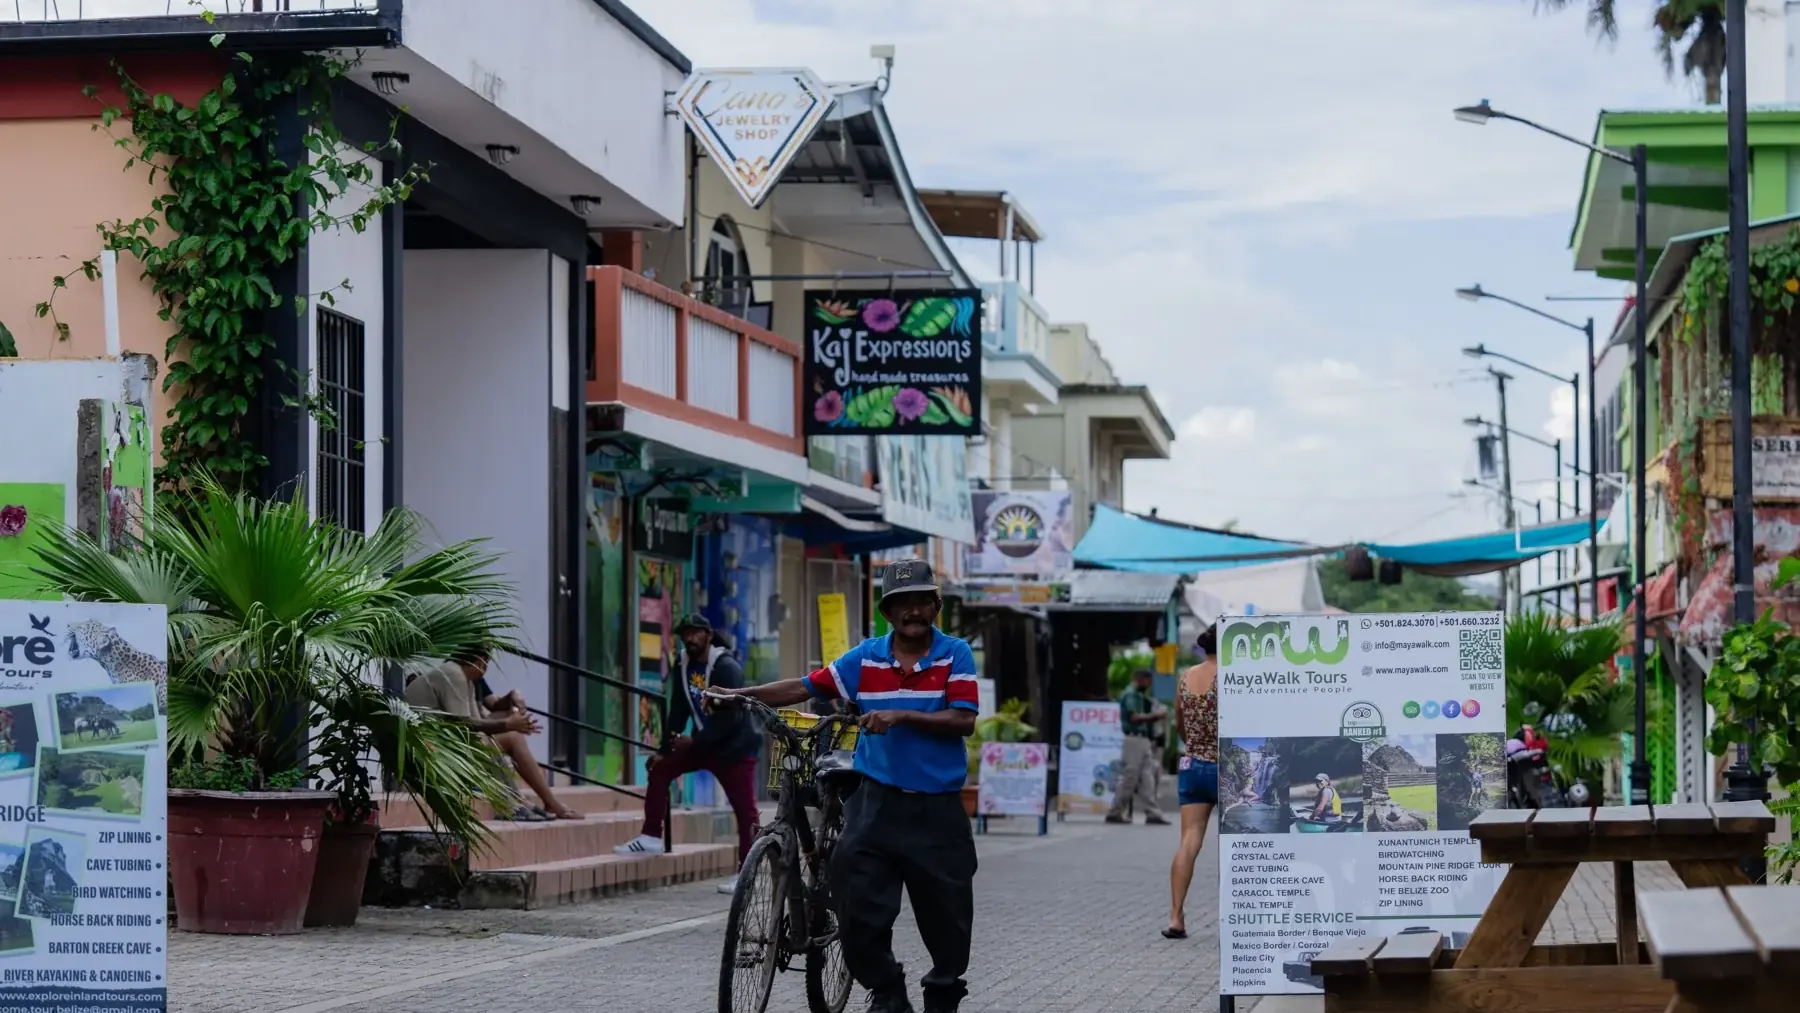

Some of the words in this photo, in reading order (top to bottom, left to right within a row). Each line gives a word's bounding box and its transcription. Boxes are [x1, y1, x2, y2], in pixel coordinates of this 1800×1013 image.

[716, 114, 792, 127] JEWELRY
[734, 129, 780, 141] SHOP
[813, 326, 852, 387] Kaj
[855, 330, 971, 364] Expressions
[880, 371, 908, 384] made
[910, 372, 970, 384] treasures
[1374, 618, 1435, 628] +501.824.3070
[1440, 616, 1500, 627] +501.660.3232
[1374, 640, 1450, 651] info@mayawalk.com
[0, 635, 55, 666] re
[1375, 665, 1449, 676] www.mayawalk.com
[1223, 672, 1301, 689] MayaWalk
[1304, 671, 1348, 684] Tours
[1460, 673, 1477, 681] SCAN
[1478, 673, 1486, 681] TO
[1487, 672, 1502, 680] VIEW
[1223, 687, 1243, 695] The
[1248, 686, 1308, 695] Adventure
[1314, 686, 1353, 695] People
[1469, 682, 1495, 691] WEBSITE
[1343, 727, 1372, 737] RANKED
[98, 831, 115, 844] ZIP
[117, 831, 152, 844] LINING
[1231, 841, 1250, 849] ATM
[1378, 838, 1440, 847] XUNANTUNICH
[1442, 838, 1477, 846] TEMPLE
[1231, 853, 1270, 861] CRYSTAL
[1272, 852, 1296, 860] CAVE
[1378, 850, 1445, 859] BIRDWATCHING
[86, 858, 112, 871] CAVE
[114, 859, 152, 871] TUBING
[1231, 865, 1254, 873] CAVE
[1257, 865, 1289, 873] TUBING
[1378, 862, 1424, 871] MOUNTAIN
[1425, 862, 1445, 870] PINE
[1477, 861, 1501, 869] TOUR
[1232, 877, 1268, 885] BARTON
[1270, 877, 1300, 885] CREEK
[1301, 876, 1325, 884] CAVE
[1378, 875, 1409, 883] HORSE
[1438, 874, 1468, 882] RIDING
[72, 886, 97, 899] BIRD
[99, 886, 152, 899] WATCHING
[1232, 889, 1274, 897] CARACOL
[1276, 888, 1311, 896] TEMPLE
[1379, 887, 1396, 895] THE
[1398, 887, 1428, 895] BELIZE
[1430, 886, 1449, 894] ZOO
[1232, 901, 1256, 909] TIKAL
[1259, 901, 1294, 909] TEMPLE
[1378, 899, 1392, 907] ZIP
[1394, 899, 1423, 907] LINING
[51, 914, 85, 927] HORSE
[86, 914, 114, 927] BACK
[116, 914, 152, 927] RIDING
[1228, 913, 1290, 925] SHUTTLE
[1294, 912, 1354, 924] SERVICE
[1277, 929, 1307, 937] Border
[1312, 929, 1344, 938] Benque
[1345, 928, 1366, 937] Viejo
[49, 942, 90, 954] BARTON
[92, 942, 124, 954] CREEK
[126, 942, 152, 955] CAVE
[1232, 942, 1261, 950] Mexico
[1263, 941, 1292, 949] Border
[1298, 941, 1329, 949] Corozal
[1232, 954, 1257, 962] Belize
[1259, 954, 1275, 963] City
[1232, 966, 1272, 974] Placencia
[4, 969, 34, 982] RIVER
[36, 969, 87, 982] KAYAKING
[89, 970, 97, 982] &
[99, 970, 152, 982] CANOEING
[1232, 978, 1266, 987] Hopkins
[0, 1004, 160, 1013] ome.tour.belize@gmail.com
